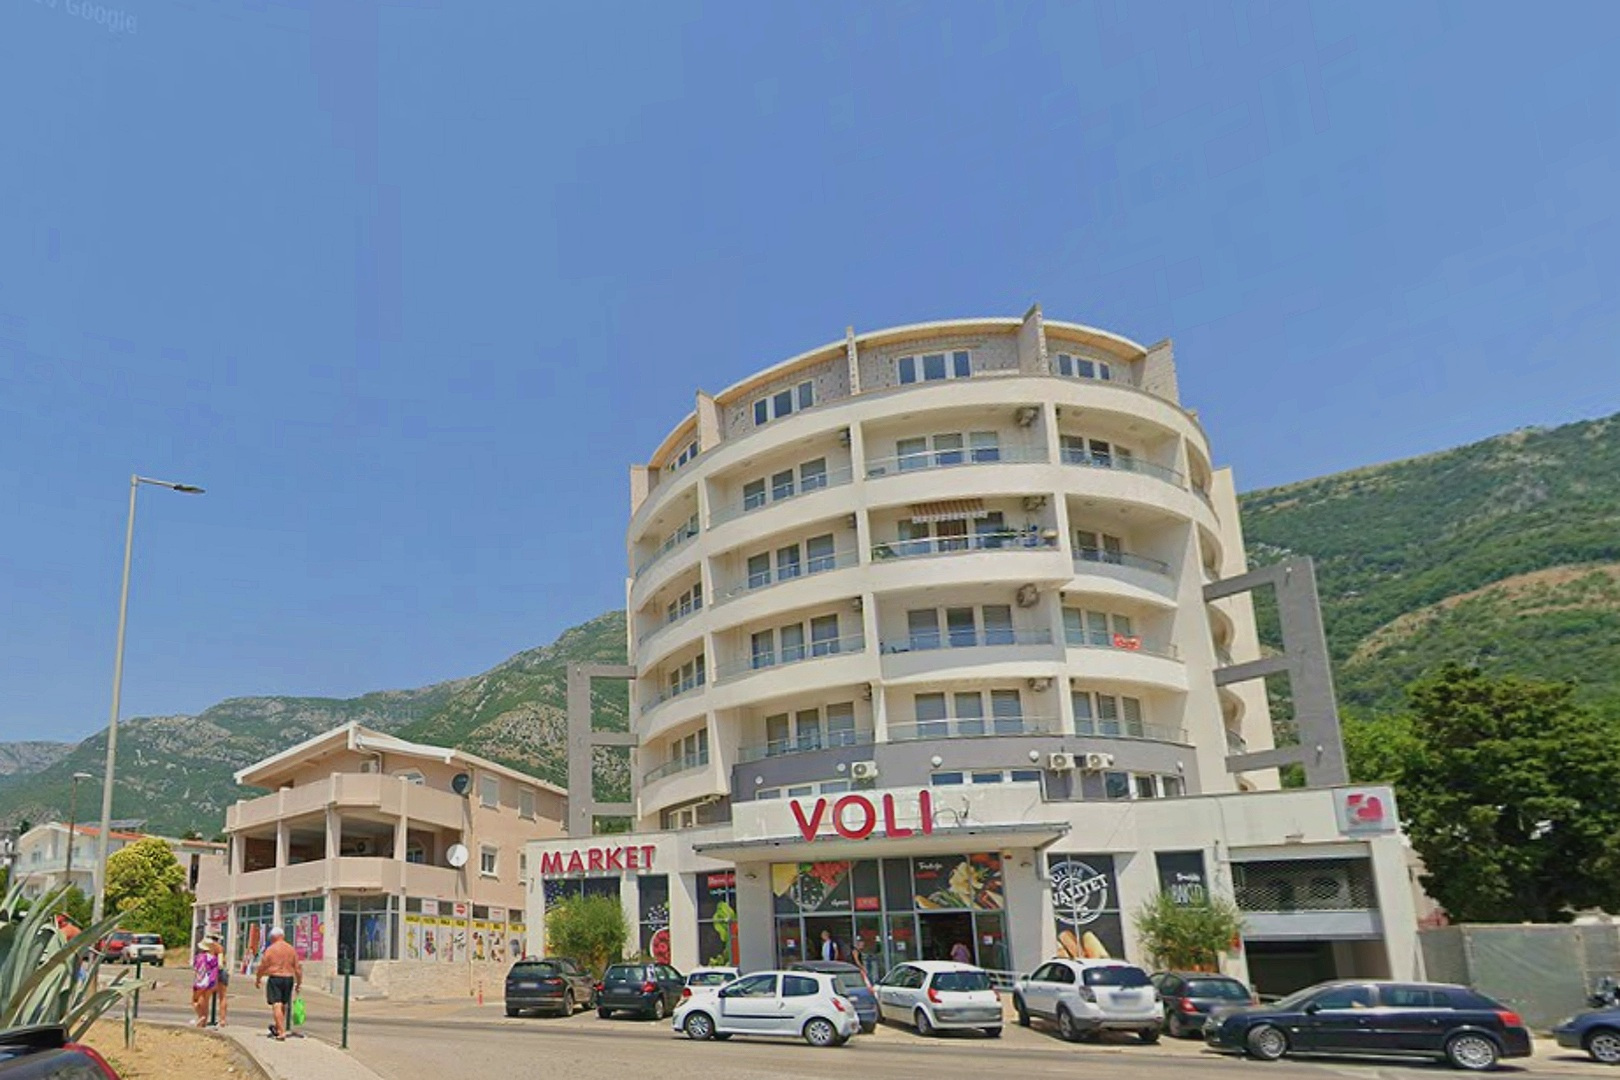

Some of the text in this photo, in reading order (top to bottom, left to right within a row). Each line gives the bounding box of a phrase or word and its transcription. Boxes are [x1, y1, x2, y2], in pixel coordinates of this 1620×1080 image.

[790, 789, 933, 842] VOLI
[540, 845, 656, 875] MARKET
[1052, 873, 1108, 907] VALITET
